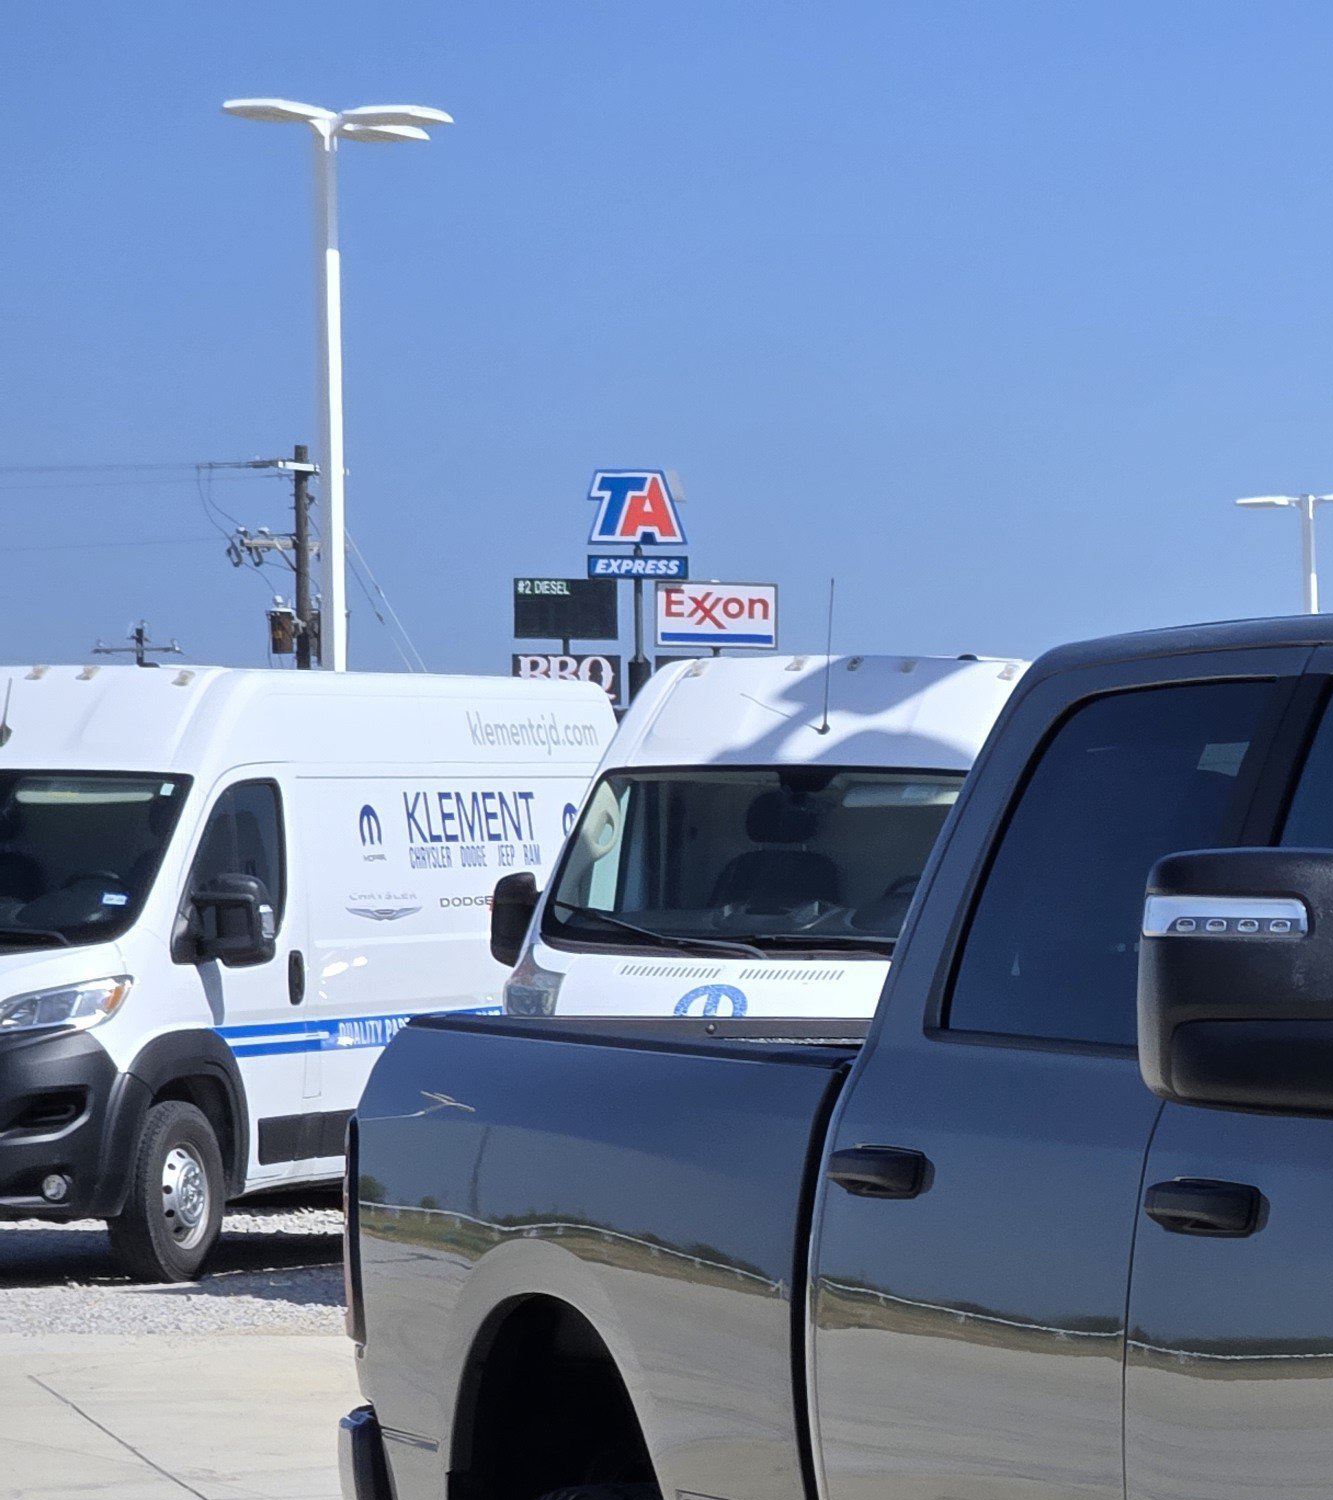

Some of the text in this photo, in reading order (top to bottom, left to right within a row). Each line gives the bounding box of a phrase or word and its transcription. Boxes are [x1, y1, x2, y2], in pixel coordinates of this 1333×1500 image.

[596, 474, 679, 538] TA
[517, 580, 571, 596] #2 DIESEL
[594, 559, 680, 575] EXPRESS
[664, 588, 770, 630] Exxon
[518, 656, 616, 699] BBQ
[466, 711, 599, 755] klementcjd.com
[403, 790, 535, 845] KLEMENT
[409, 844, 542, 869] CHRYSLER DODGE JEEP RAM
[440, 895, 493, 908] DODGE
